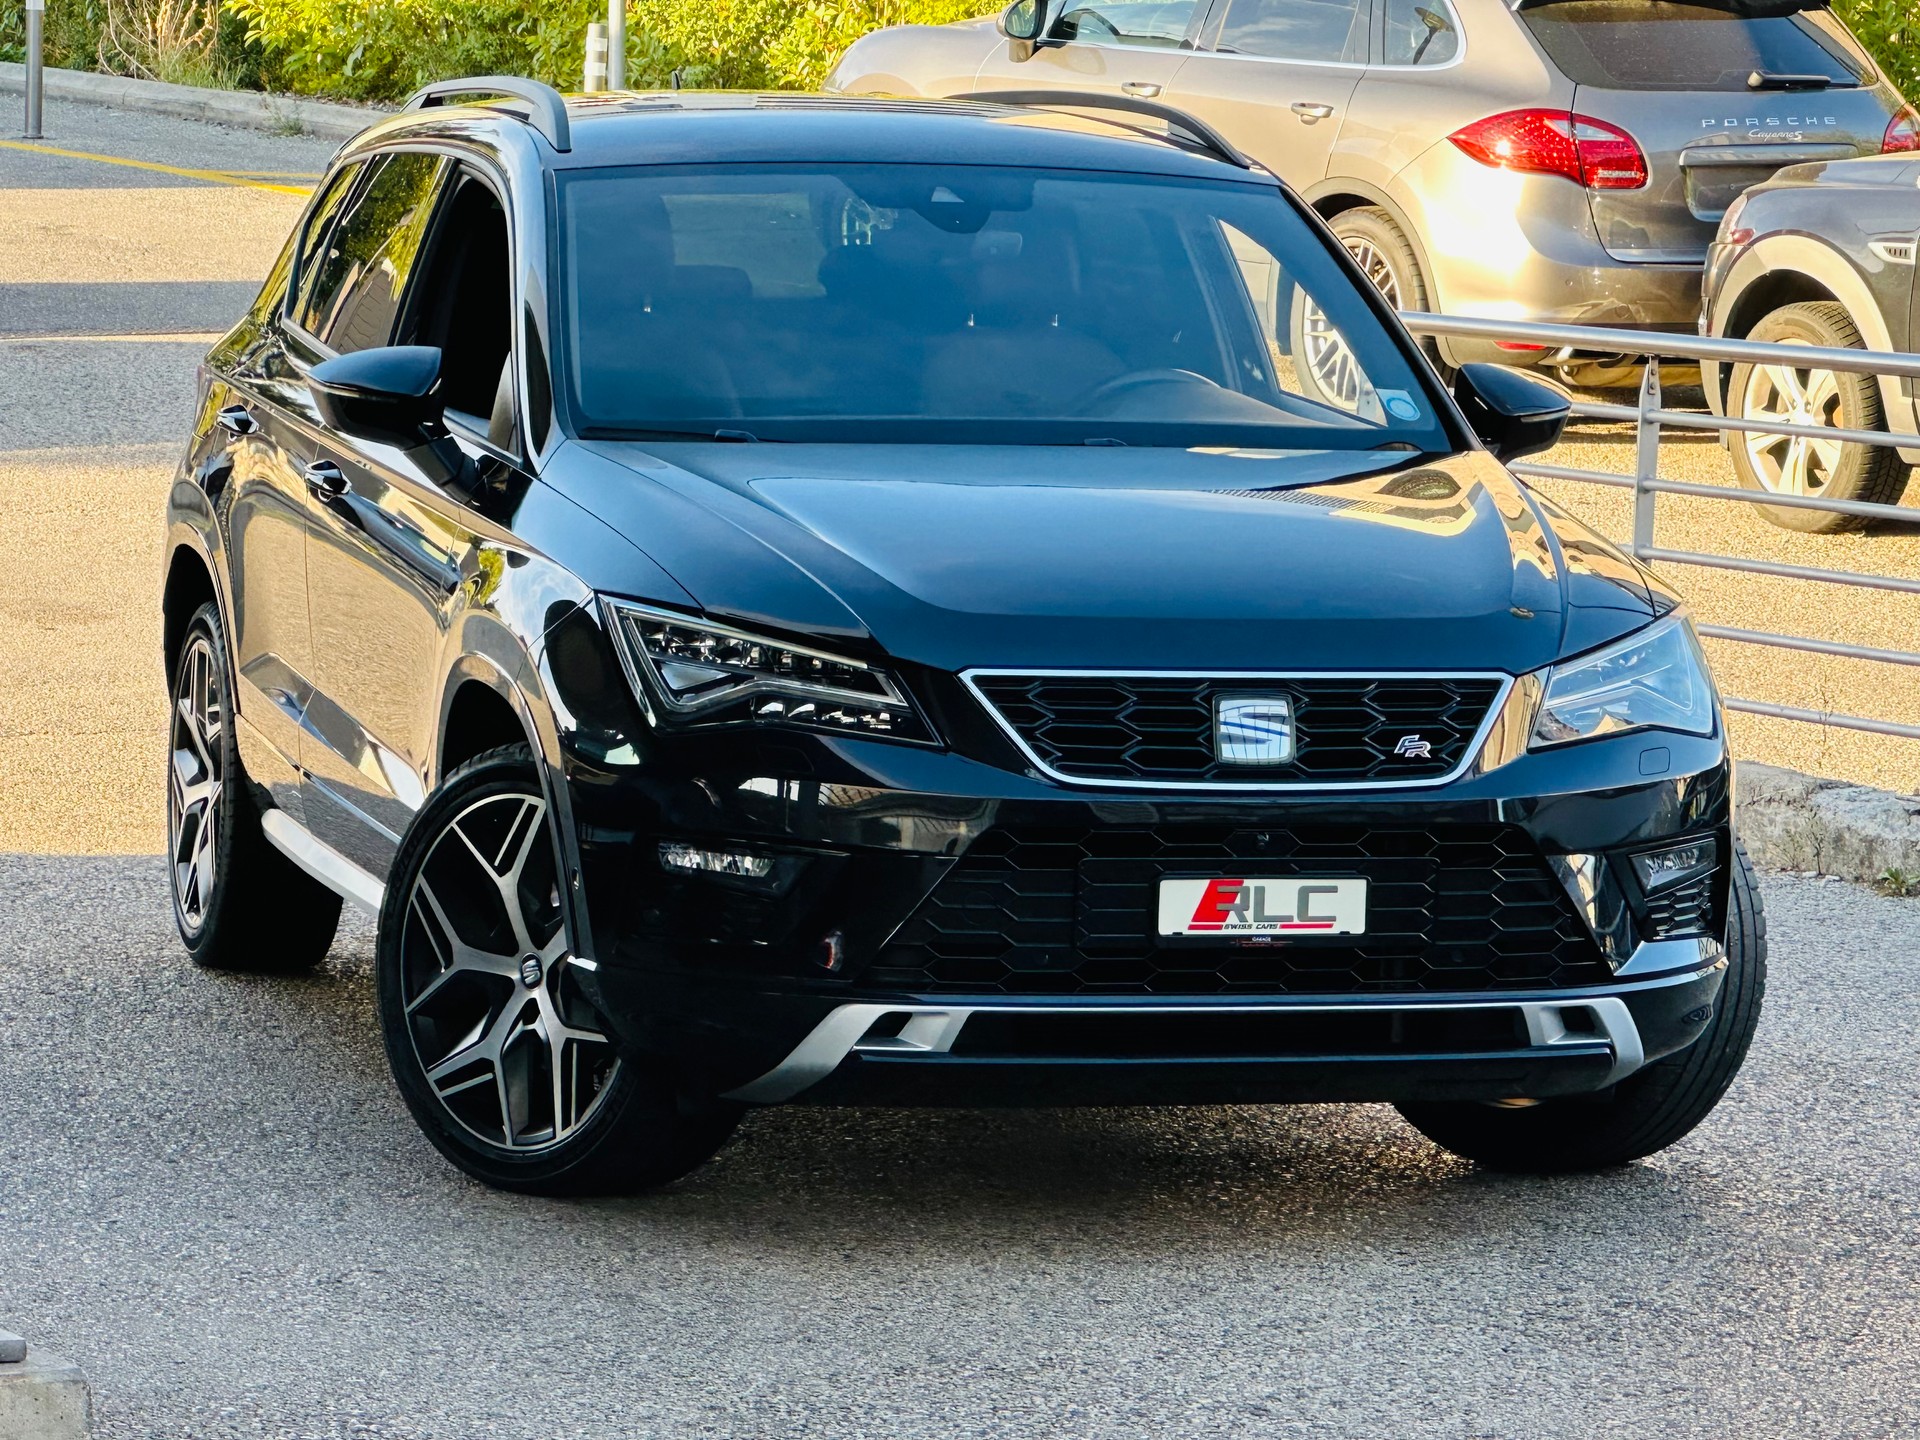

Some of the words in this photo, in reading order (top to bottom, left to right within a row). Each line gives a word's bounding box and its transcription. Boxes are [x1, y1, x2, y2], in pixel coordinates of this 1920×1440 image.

[1701, 116, 1837, 128] PORSCHE
[1748, 128, 1794, 142] Cayenne
[1393, 734, 1432, 758] FR
